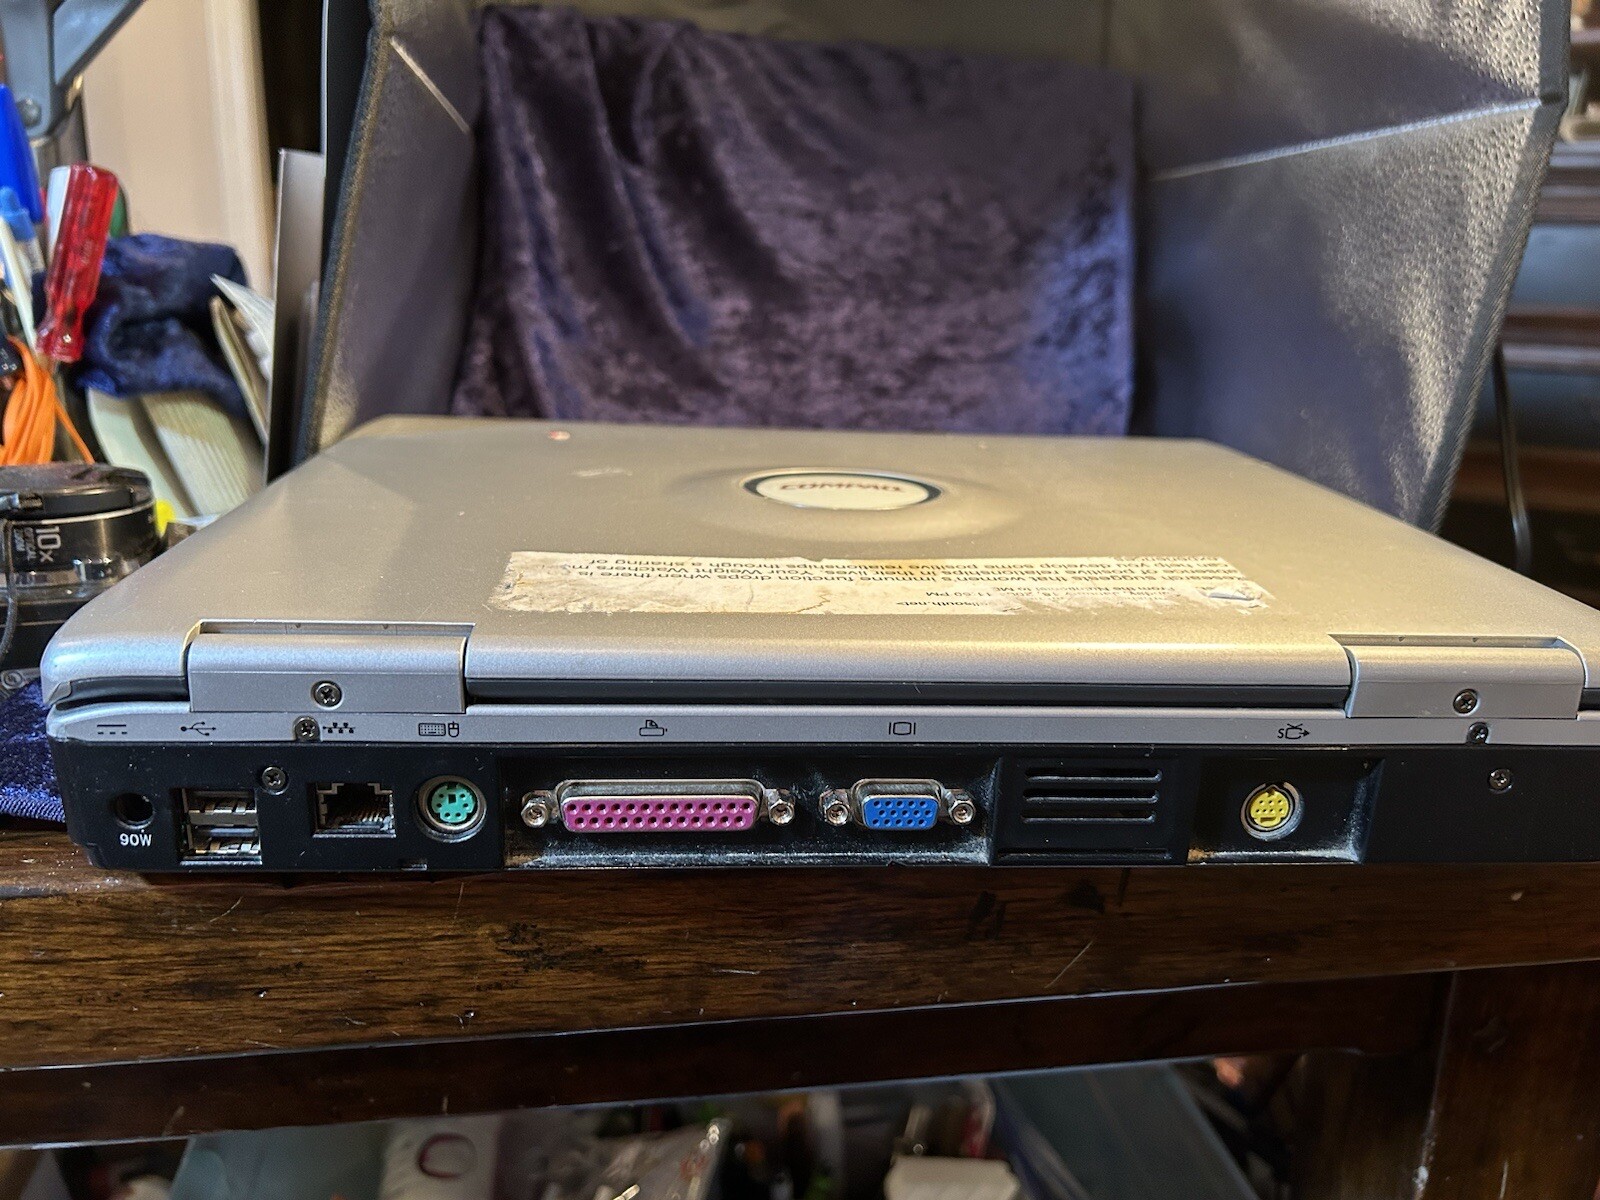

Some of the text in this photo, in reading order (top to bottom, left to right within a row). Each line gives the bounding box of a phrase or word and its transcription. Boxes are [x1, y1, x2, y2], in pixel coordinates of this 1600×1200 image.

[780, 482, 902, 492] COMPAQ
[36, 526, 61, 562] 10x
[596, 566, 688, 574] Watchers
[120, 833, 152, 846] 90W
